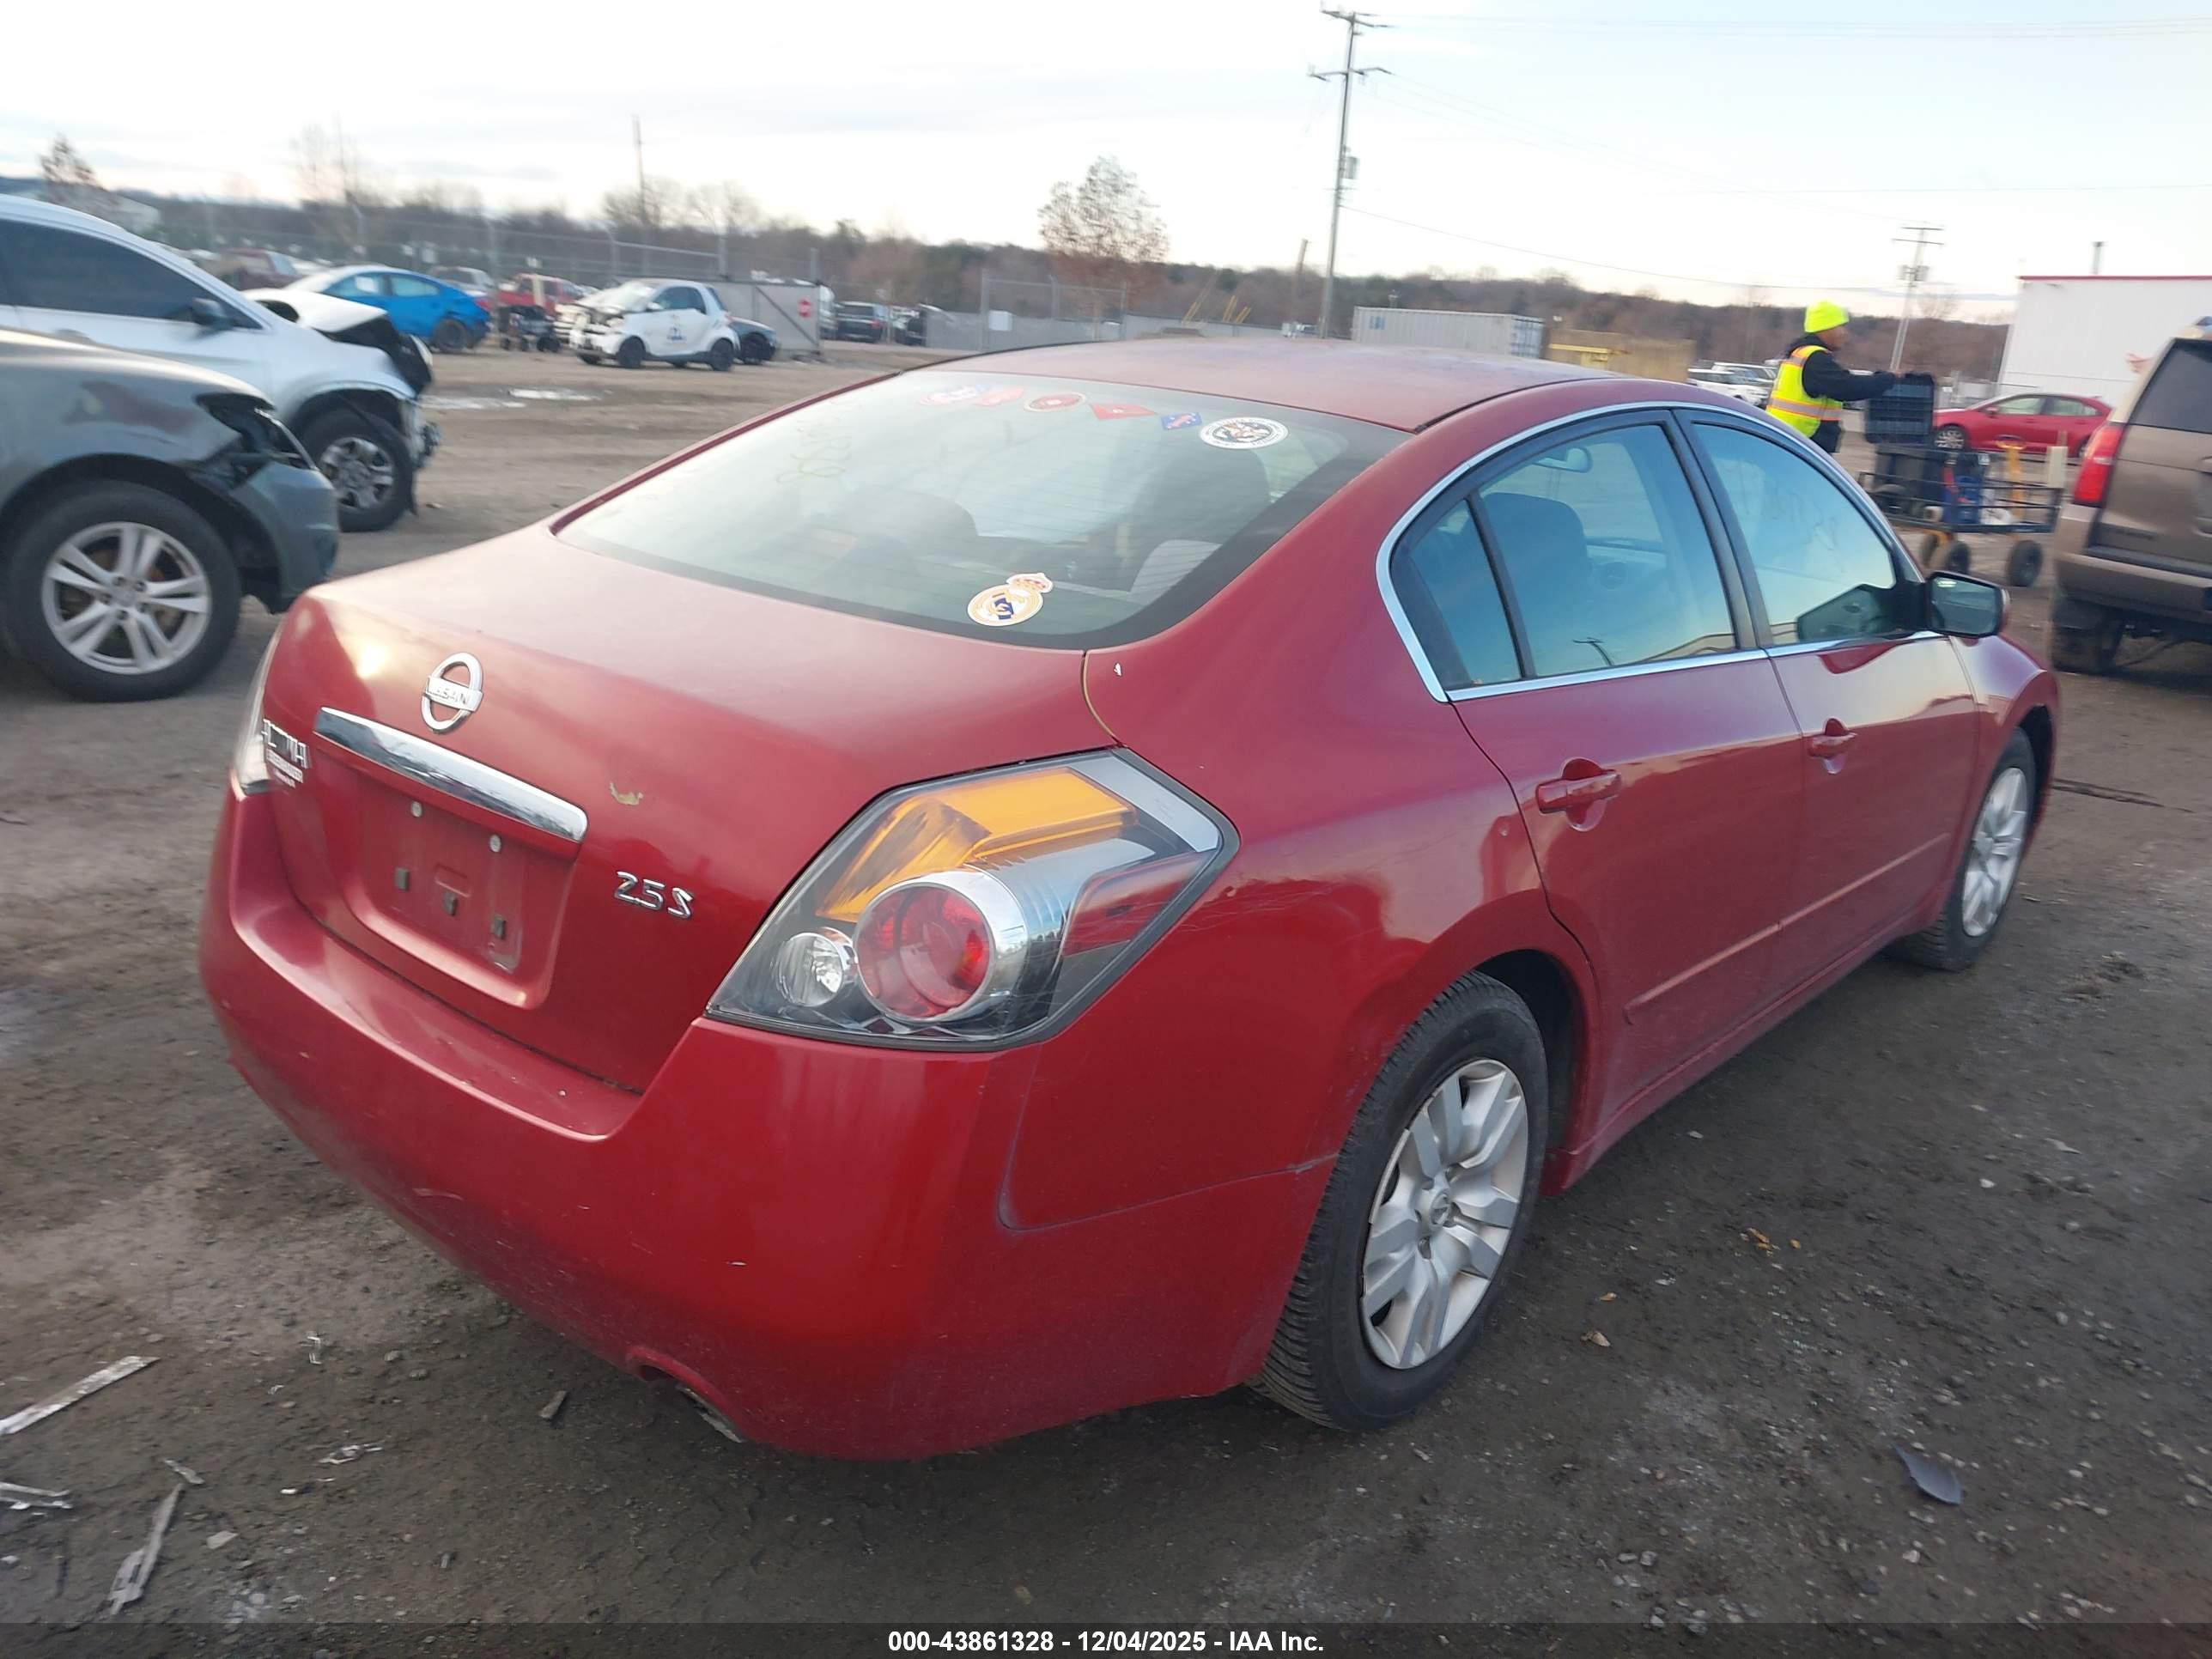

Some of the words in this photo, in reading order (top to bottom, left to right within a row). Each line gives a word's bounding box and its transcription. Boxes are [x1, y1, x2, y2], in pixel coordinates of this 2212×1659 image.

[427, 678, 475, 708] SSAN
[261, 718, 311, 769] ALMA
[667, 887, 693, 918] S
